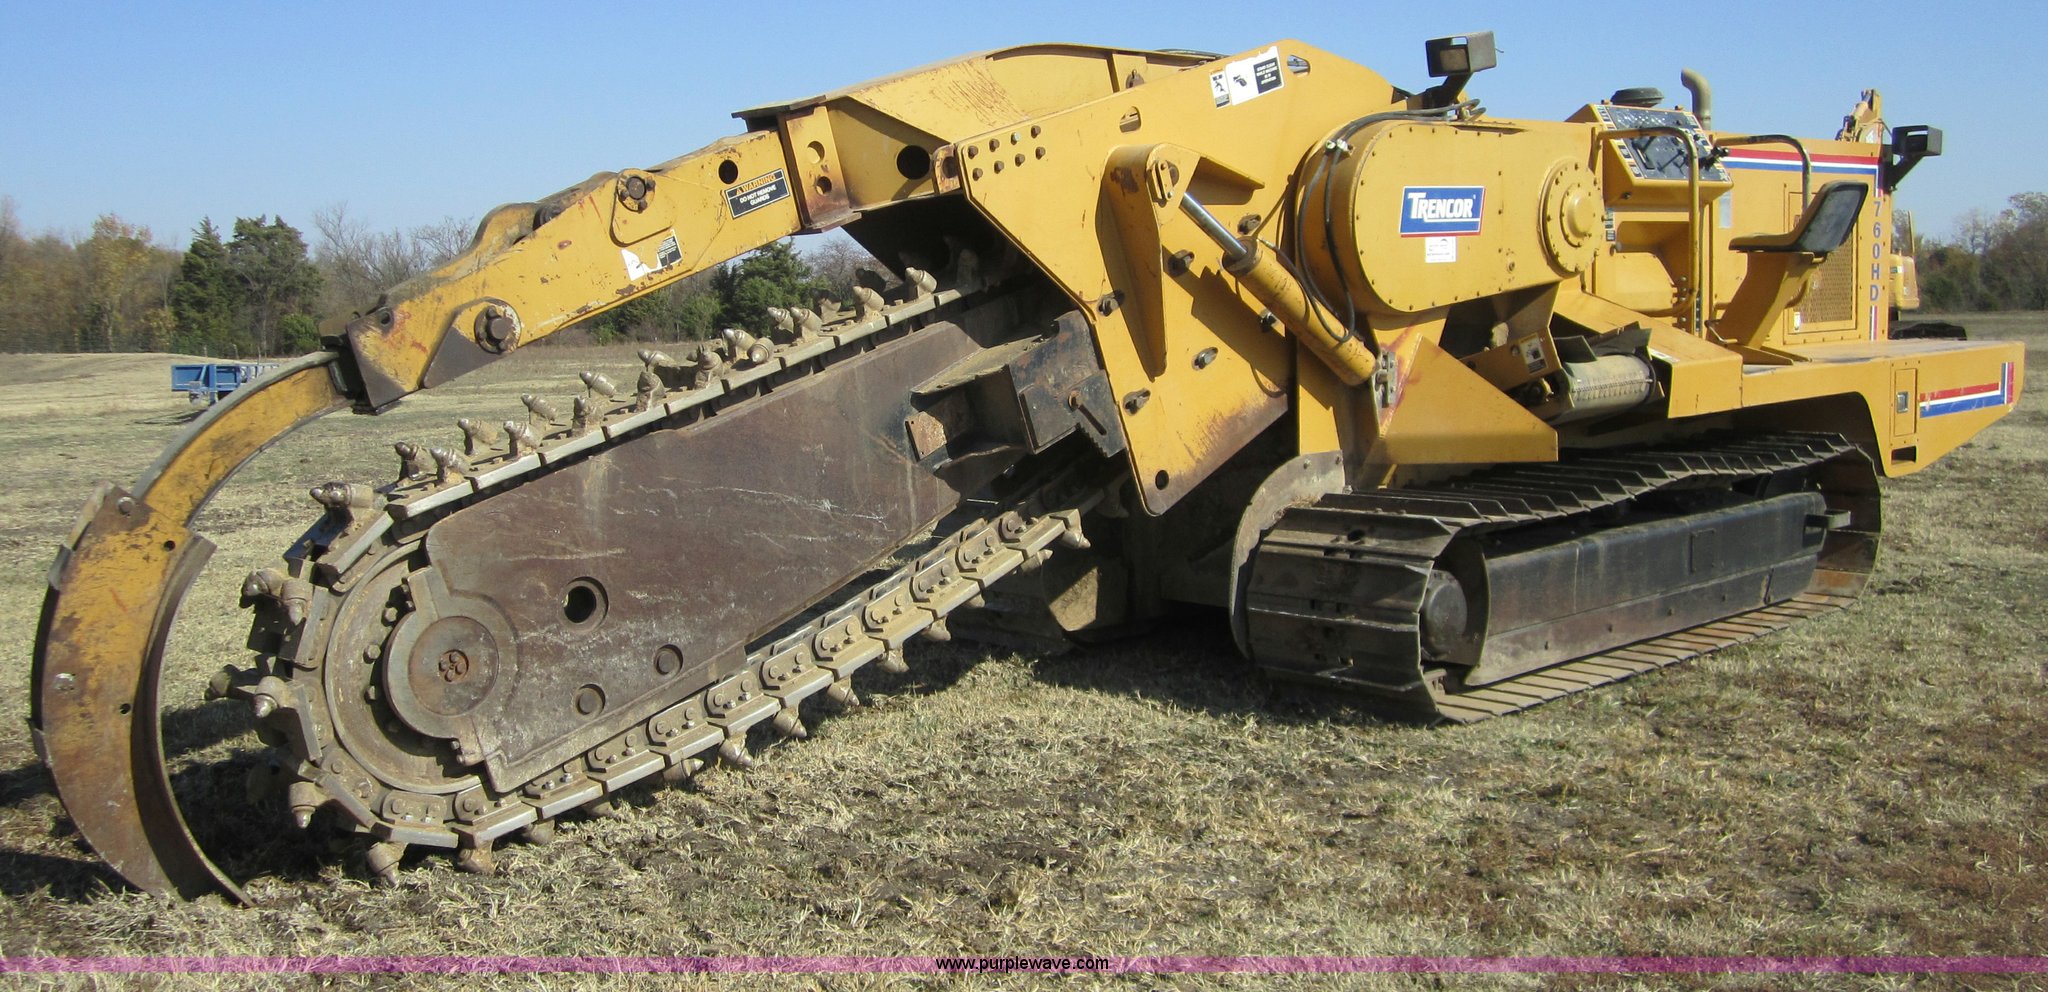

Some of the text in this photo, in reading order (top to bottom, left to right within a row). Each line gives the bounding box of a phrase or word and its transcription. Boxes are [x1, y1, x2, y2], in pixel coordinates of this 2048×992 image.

[742, 173, 776, 192] WARNING
[747, 192, 757, 200] NOT
[757, 184, 777, 196] REMOVE
[1407, 192, 1474, 220] TRENCOR
[1870, 201, 1881, 301] 760HD
